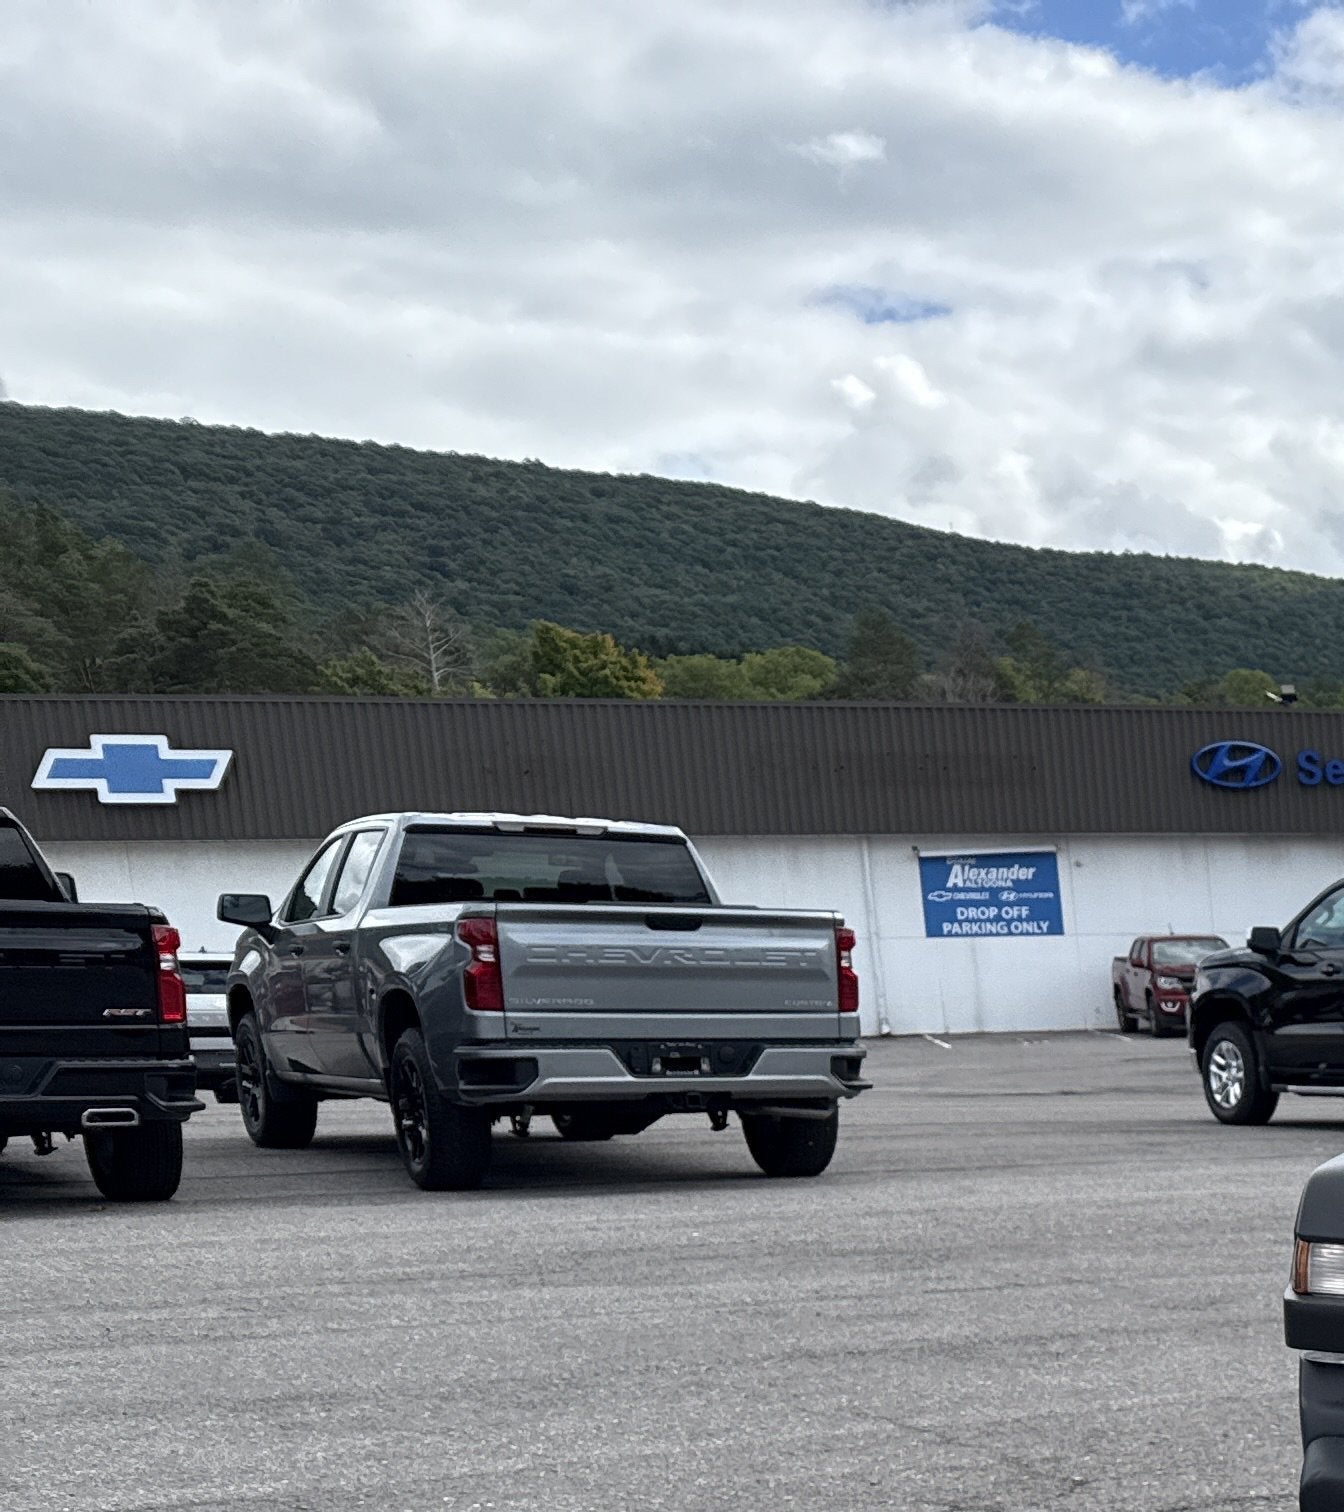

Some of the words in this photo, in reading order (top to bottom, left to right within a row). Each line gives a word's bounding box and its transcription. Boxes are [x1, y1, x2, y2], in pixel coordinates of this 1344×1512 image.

[946, 864, 1036, 888] Alexander
[956, 906, 998, 920] DROP
[1001, 905, 1030, 919] OFF
[942, 921, 1008, 935] PARKING
[1010, 920, 1050, 934] ONLY
